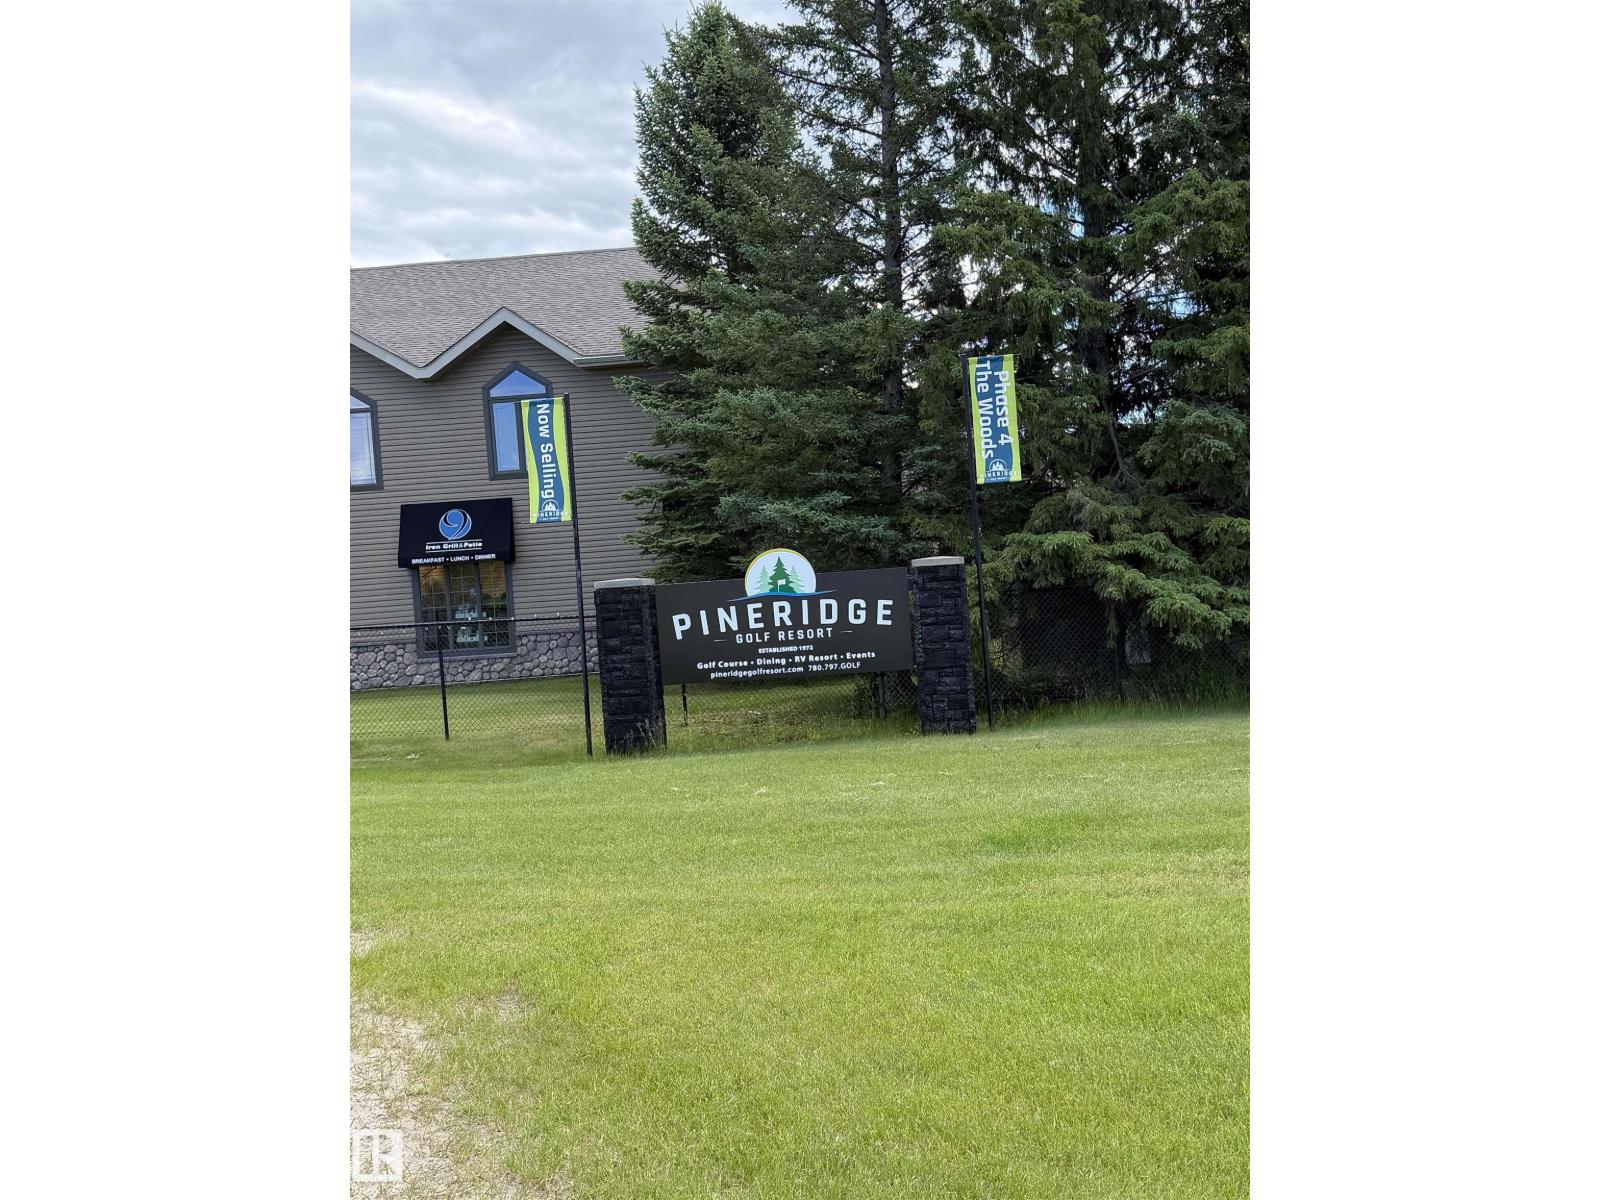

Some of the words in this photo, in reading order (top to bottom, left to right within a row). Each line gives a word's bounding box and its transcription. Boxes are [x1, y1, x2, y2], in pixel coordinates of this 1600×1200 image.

[976, 360, 993, 393] The
[994, 371, 1011, 428] Phase
[536, 403, 550, 438] Now
[978, 397, 998, 460] Woods
[998, 433, 1013, 446] 4
[540, 443, 557, 499] Selling
[672, 598, 894, 641] PINERIDGE
[736, 631, 771, 644] GOLF
[778, 627, 833, 641] RESORT
[697, 661, 716, 669] Golf
[718, 660, 749, 668] Course
[756, 657, 786, 666] Dining
[794, 655, 806, 663] RV
[808, 653, 838, 662] Resort
[846, 651, 876, 659] Events
[758, 646, 798, 654] ESTABLISHED
[710, 665, 804, 680] pineridgegolfresort.com
[808, 661, 861, 672] 780.797.GOLF
